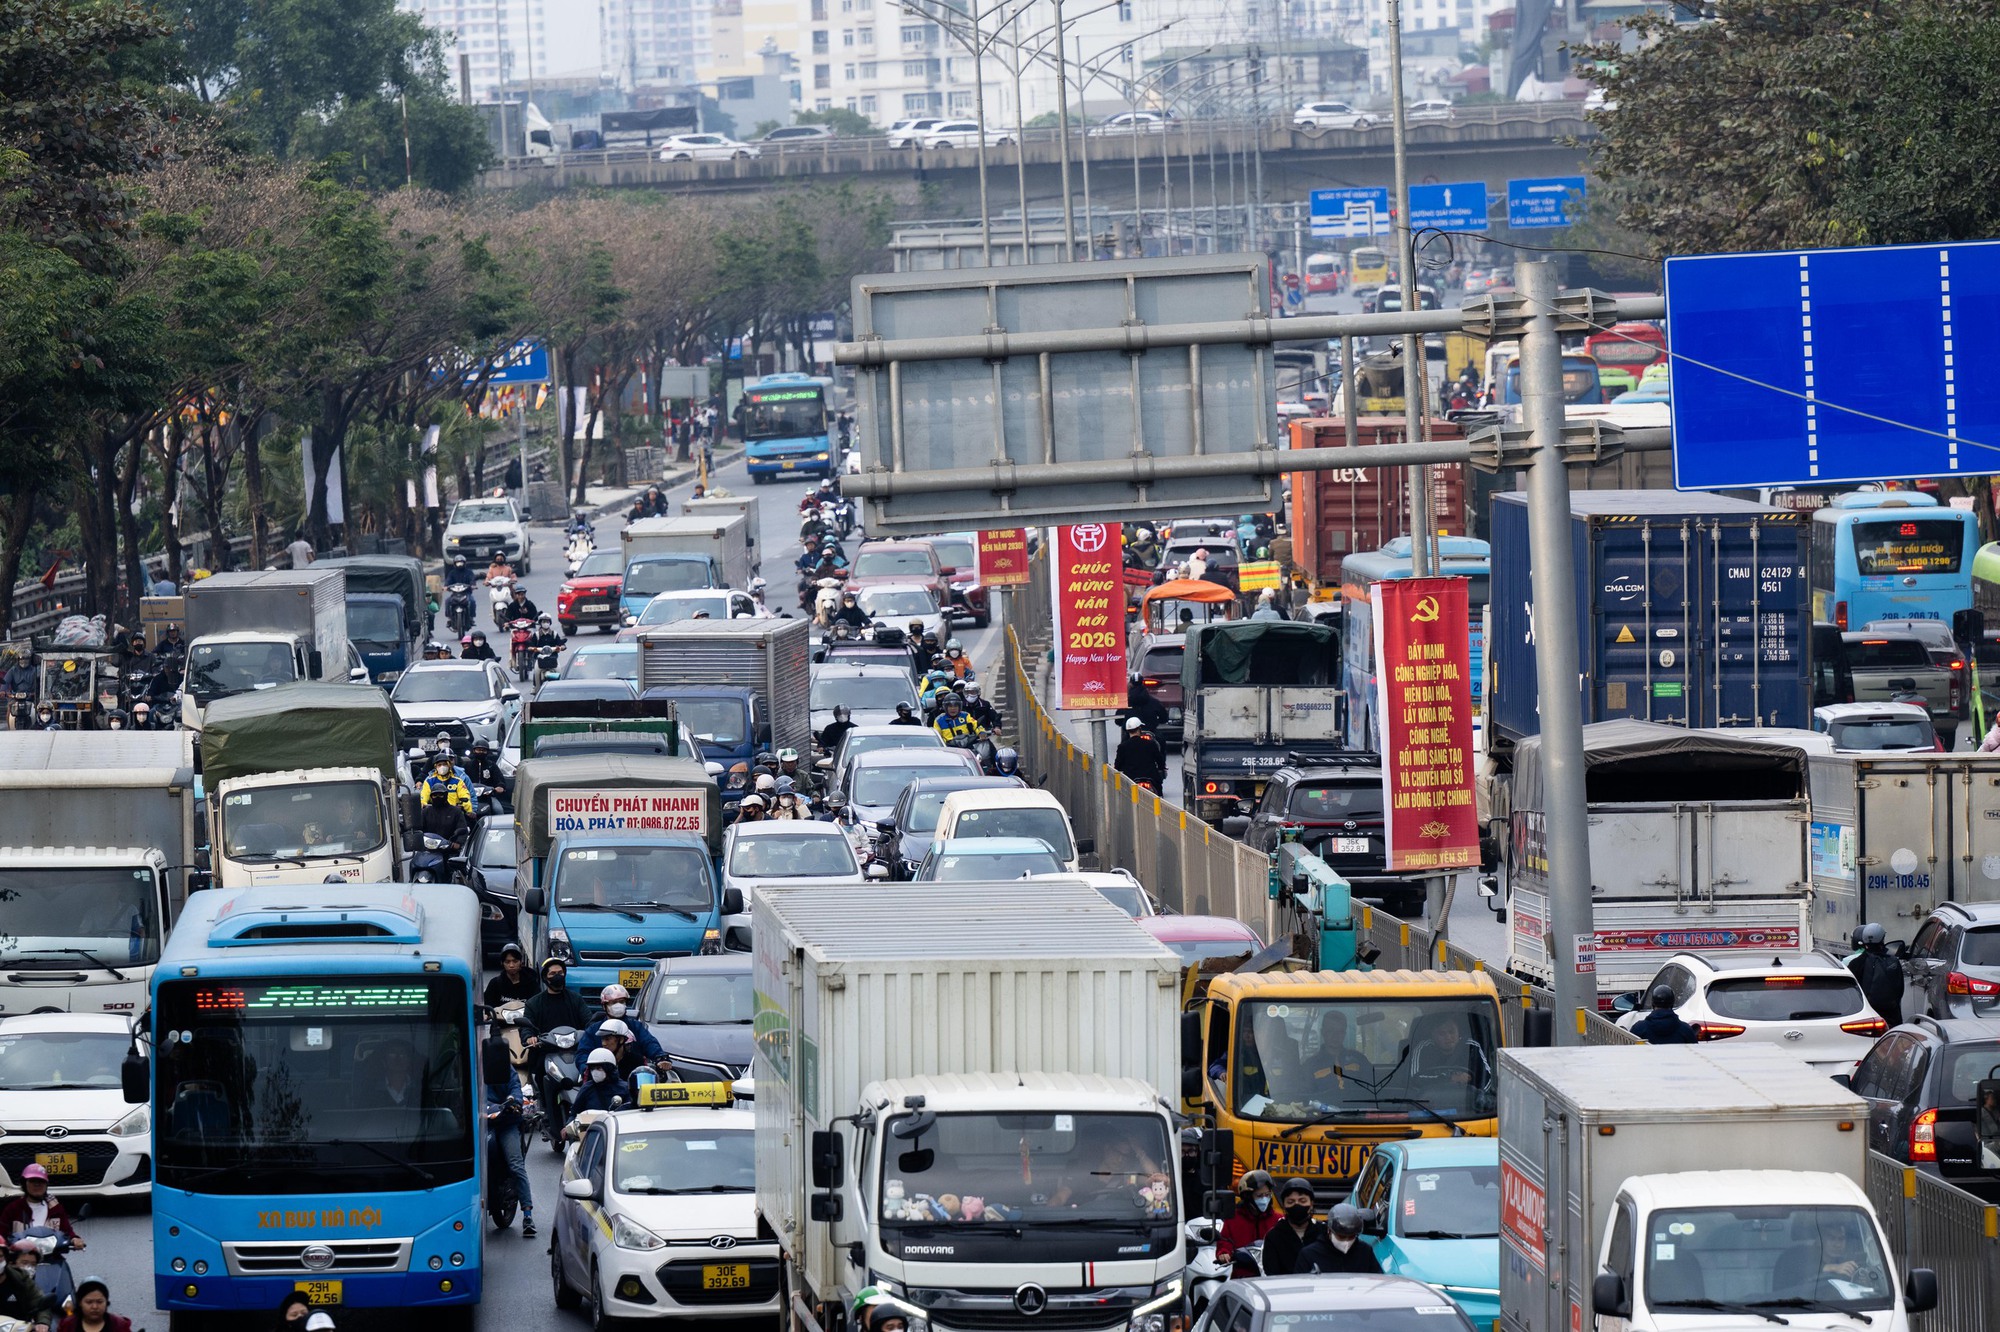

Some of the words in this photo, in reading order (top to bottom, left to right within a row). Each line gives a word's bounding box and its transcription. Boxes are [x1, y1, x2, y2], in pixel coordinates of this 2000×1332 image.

[1071, 561, 1112, 574] CHÚC
[1728, 568, 1750, 578] CMAU
[1761, 567, 1792, 578] 624129
[1799, 566, 1805, 578] 4
[1068, 580, 1114, 592] MỪNG
[1761, 582, 1782, 592] 45G1
[1074, 596, 1109, 609] NĂM
[1077, 614, 1108, 627] MỚI
[1070, 632, 1116, 649] 2026
[1408, 639, 1422, 660] ĐẨY
[1424, 644, 1445, 662] MẠNH
[1065, 654, 1087, 665] Happy
[1089, 654, 1105, 662] New
[1105, 654, 1122, 662] Year
[1395, 663, 1414, 682] CÔNG
[1416, 663, 1440, 683] NGHIỆP
[1443, 661, 1460, 680] HÓA,
[1404, 684, 1421, 705] HIỆN
[1422, 686, 1435, 705] ĐẠI
[1436, 682, 1452, 702] HÓA,
[1071, 695, 1096, 706] PHƯỜNG
[1097, 696, 1109, 706] YÊN
[1404, 703, 1416, 724] LẤY
[1418, 708, 1437, 723] KHOA
[1438, 706, 1454, 725] HỌC,
[1409, 726, 1429, 745] CÔNG
[1431, 724, 1451, 746] NGHỆ,
[1399, 745, 1412, 766] ĐỔI
[1413, 747, 1428, 765] MỚI
[1430, 746, 1448, 764] SÁNG
[1449, 748, 1462, 767] TẠO
[1400, 769, 1410, 787] VÀ
[1412, 766, 1439, 787] CHUYỂN
[1440, 763, 1452, 785] ĐỔI
[1454, 763, 1464, 784] SỐ
[556, 793, 609, 812] CHUYỂN
[614, 796, 648, 811] PHÁT
[653, 798, 699, 811] NHANH
[1394, 790, 1410, 809] LÀM
[1411, 789, 1431, 811] ĐỘNG
[1433, 791, 1445, 810] LỰC
[1447, 787, 1472, 806] CHÍNH!
[556, 814, 585, 830] HÒA
[588, 814, 625, 830] PHÁT
[1405, 851, 1438, 865] PHƯỜNG
[1439, 850, 1455, 863] YÊN
[1457, 848, 1468, 862] SỞ
[654, 1090, 687, 1099] EMDI
[48, 1155, 65, 1163] 36A
[1268, 1164, 1320, 1174] HINO
[258, 1212, 281, 1228] XN
[285, 1210, 316, 1228] BUS
[322, 1206, 344, 1227] HÀ
[350, 1206, 381, 1230] NỘI
[716, 1266, 736, 1276] 30E
[309, 1283, 329, 1292] 29H
[709, 1277, 745, 1287] 392.69
